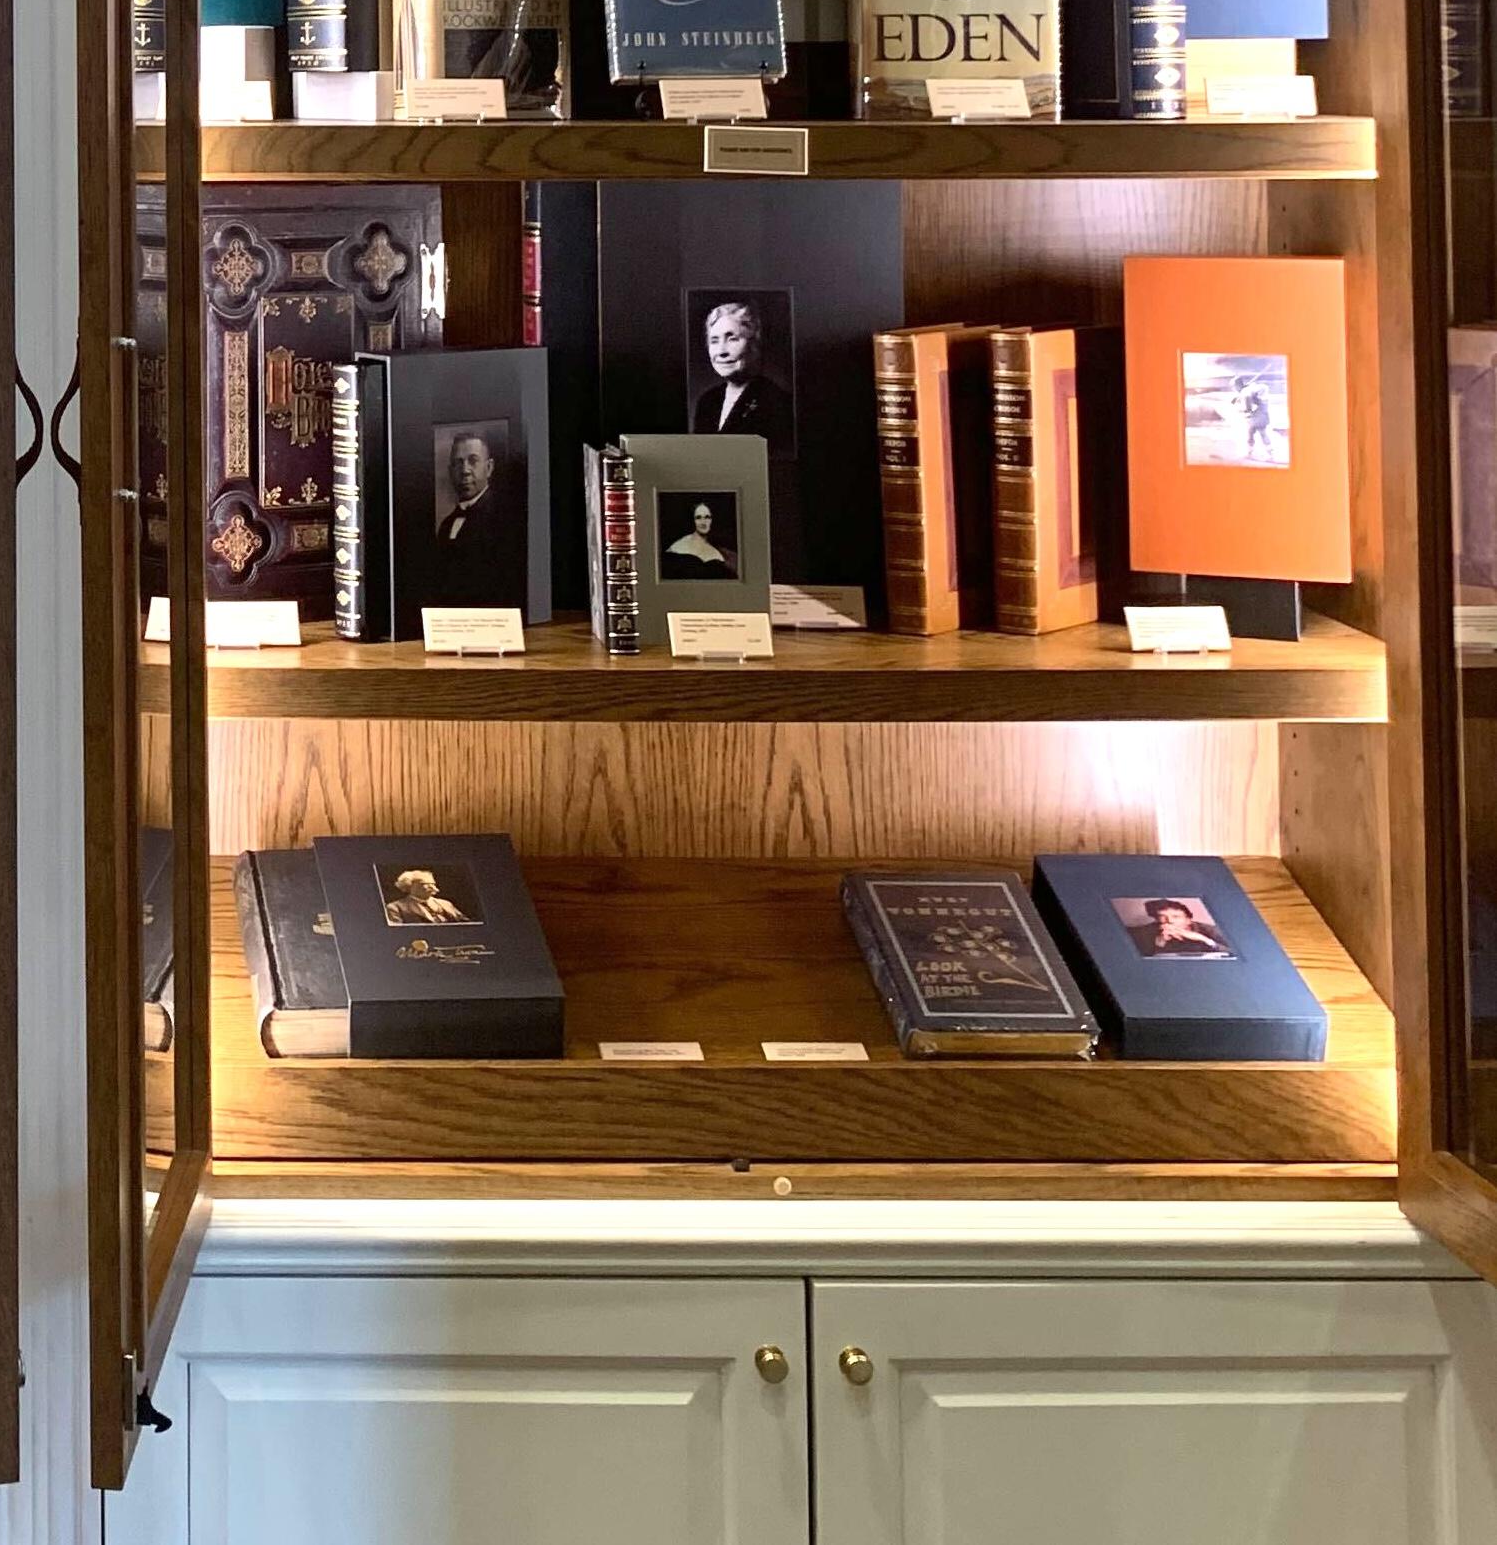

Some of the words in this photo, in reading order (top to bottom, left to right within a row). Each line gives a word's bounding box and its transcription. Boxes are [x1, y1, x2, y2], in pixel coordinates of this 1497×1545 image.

[622, 32, 666, 47] JOHN
[681, 31, 775, 48] STEINBECK
[873, 13, 1046, 62] EDEN
[886, 907, 1013, 916] VONNEGUT
[914, 961, 968, 973] LOOK
[920, 974, 939, 984] AT
[941, 974, 975, 984] THE
[923, 985, 983, 999] BIRDIE
